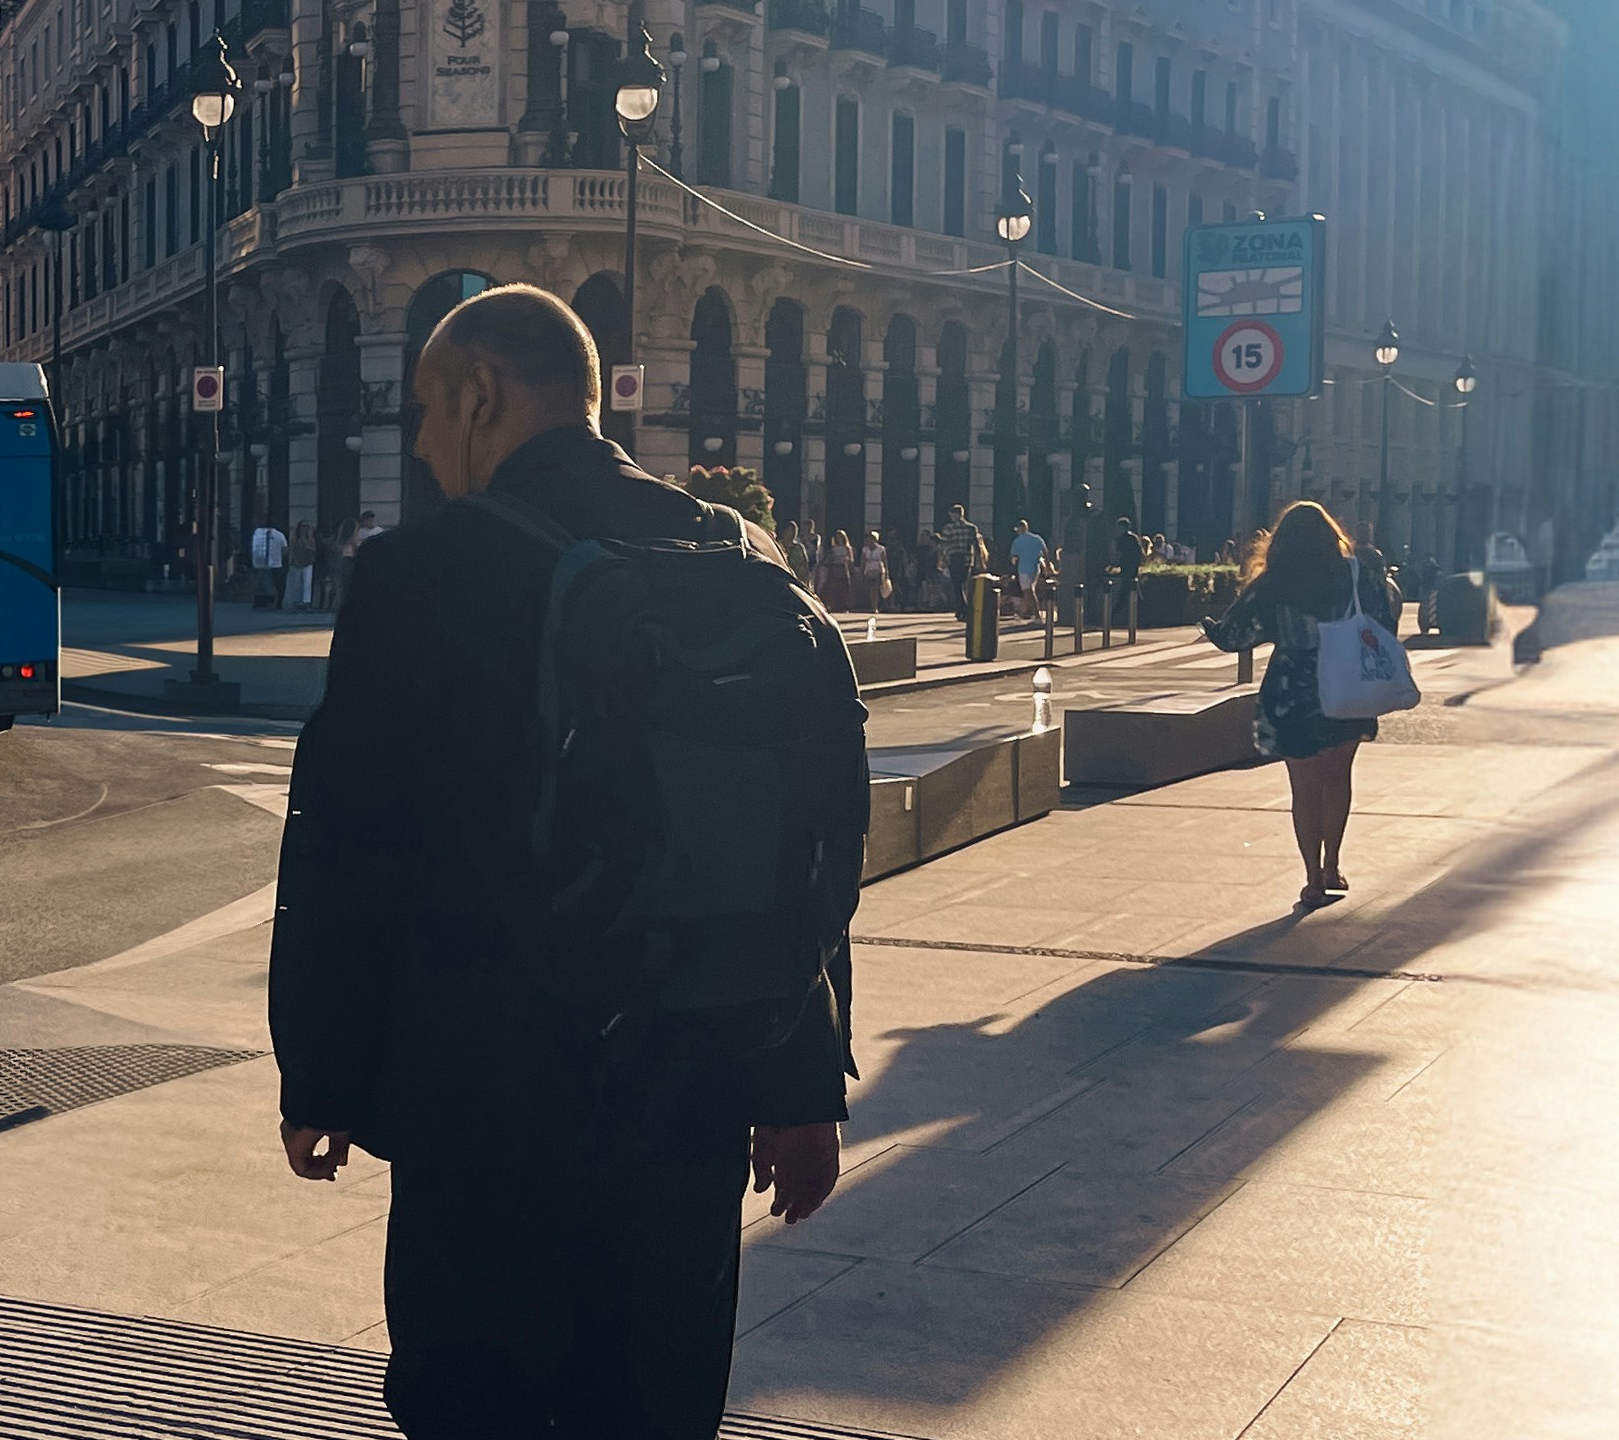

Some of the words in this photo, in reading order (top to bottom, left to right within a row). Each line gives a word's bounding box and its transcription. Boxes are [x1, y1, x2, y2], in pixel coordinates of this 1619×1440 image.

[447, 55, 480, 65] FOUR
[436, 66, 491, 77] SEASONS
[1233, 231, 1304, 252] ZONA
[1231, 342, 1263, 370] 15
